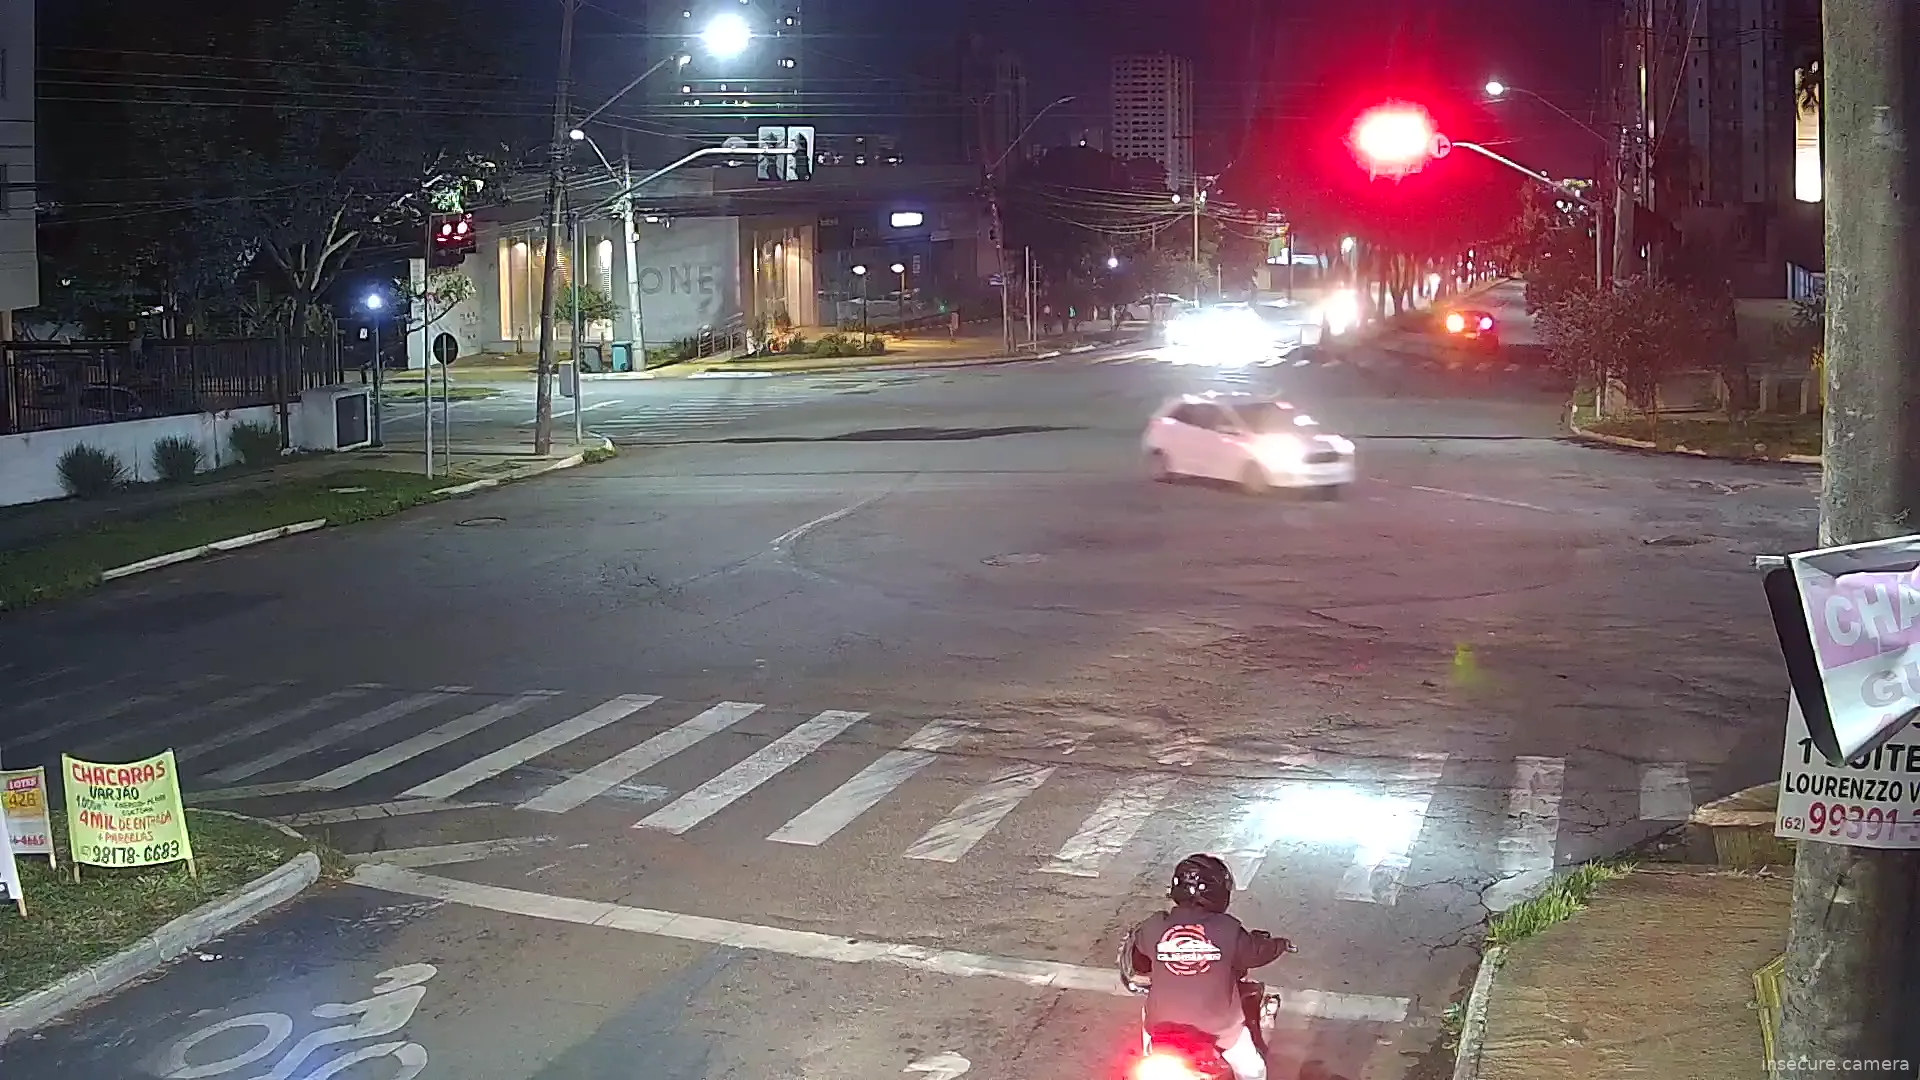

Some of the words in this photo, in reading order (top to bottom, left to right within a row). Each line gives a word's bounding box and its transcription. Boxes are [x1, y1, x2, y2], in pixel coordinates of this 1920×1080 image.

[640, 266, 713, 294] ONE
[1825, 743, 1920, 772] UITE
[1785, 772, 1903, 802] LOURENZZO
[1780, 816, 1805, 832] (62)
